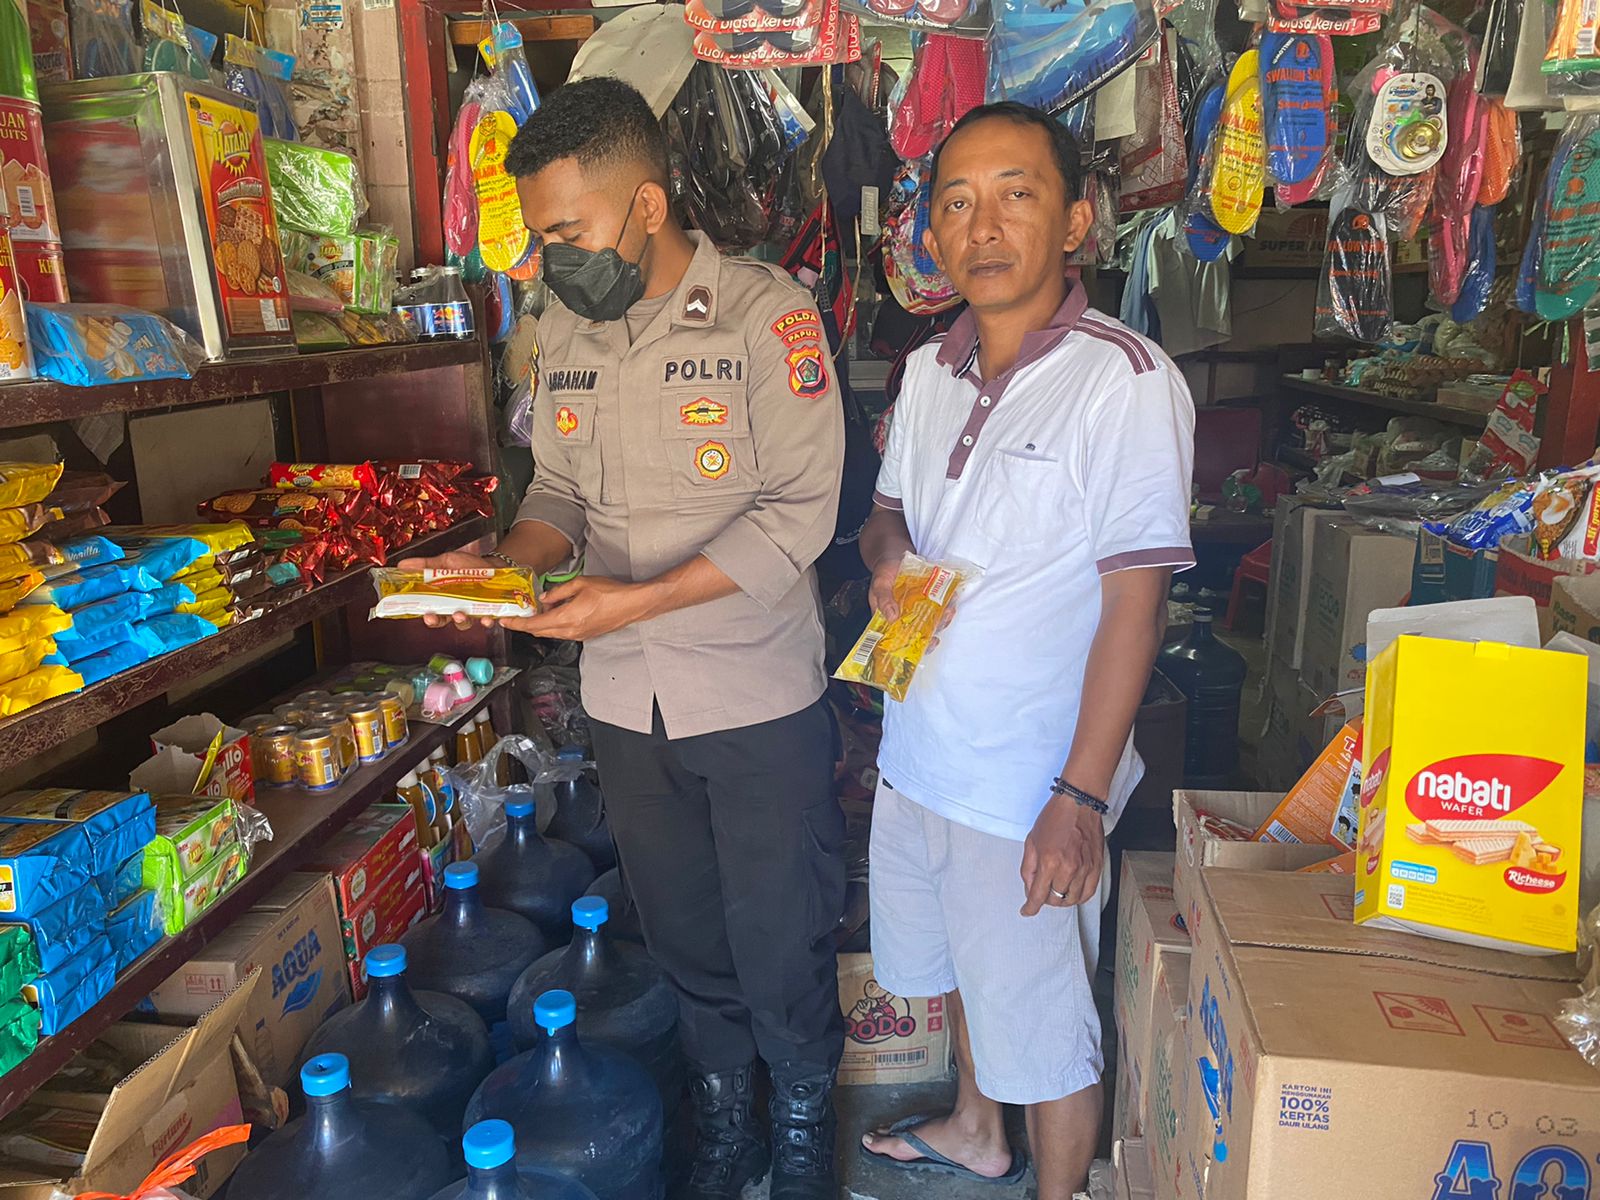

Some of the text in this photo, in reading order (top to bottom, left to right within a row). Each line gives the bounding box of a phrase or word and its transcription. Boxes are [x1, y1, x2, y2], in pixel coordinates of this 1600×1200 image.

[688, 11, 717, 29] Luar
[776, 312, 817, 332] POLDA
[787, 330, 817, 343] PAPUA
[665, 358, 742, 382] POLRI
[549, 370, 598, 393] ABRAHAM
[66, 545, 99, 561] Vanilla
[929, 569, 951, 598] Fortune
[1417, 771, 1512, 812] nabati
[1440, 801, 1484, 817] WAFER
[1508, 869, 1556, 889] Richeese
[271, 927, 322, 999] AQUA
[1281, 1084, 1317, 1092] KARTON
[1281, 1090, 1332, 1100] MENGGUNAKAN
[1280, 1096, 1330, 1113] 100%
[1279, 1110, 1330, 1123] KERTAS
[1279, 1120, 1330, 1131] DAUR ULANG
[1466, 1108, 1578, 1137] 10 03
[150, 1111, 188, 1158] Fortune
[1431, 1139, 1600, 1200] AQ
